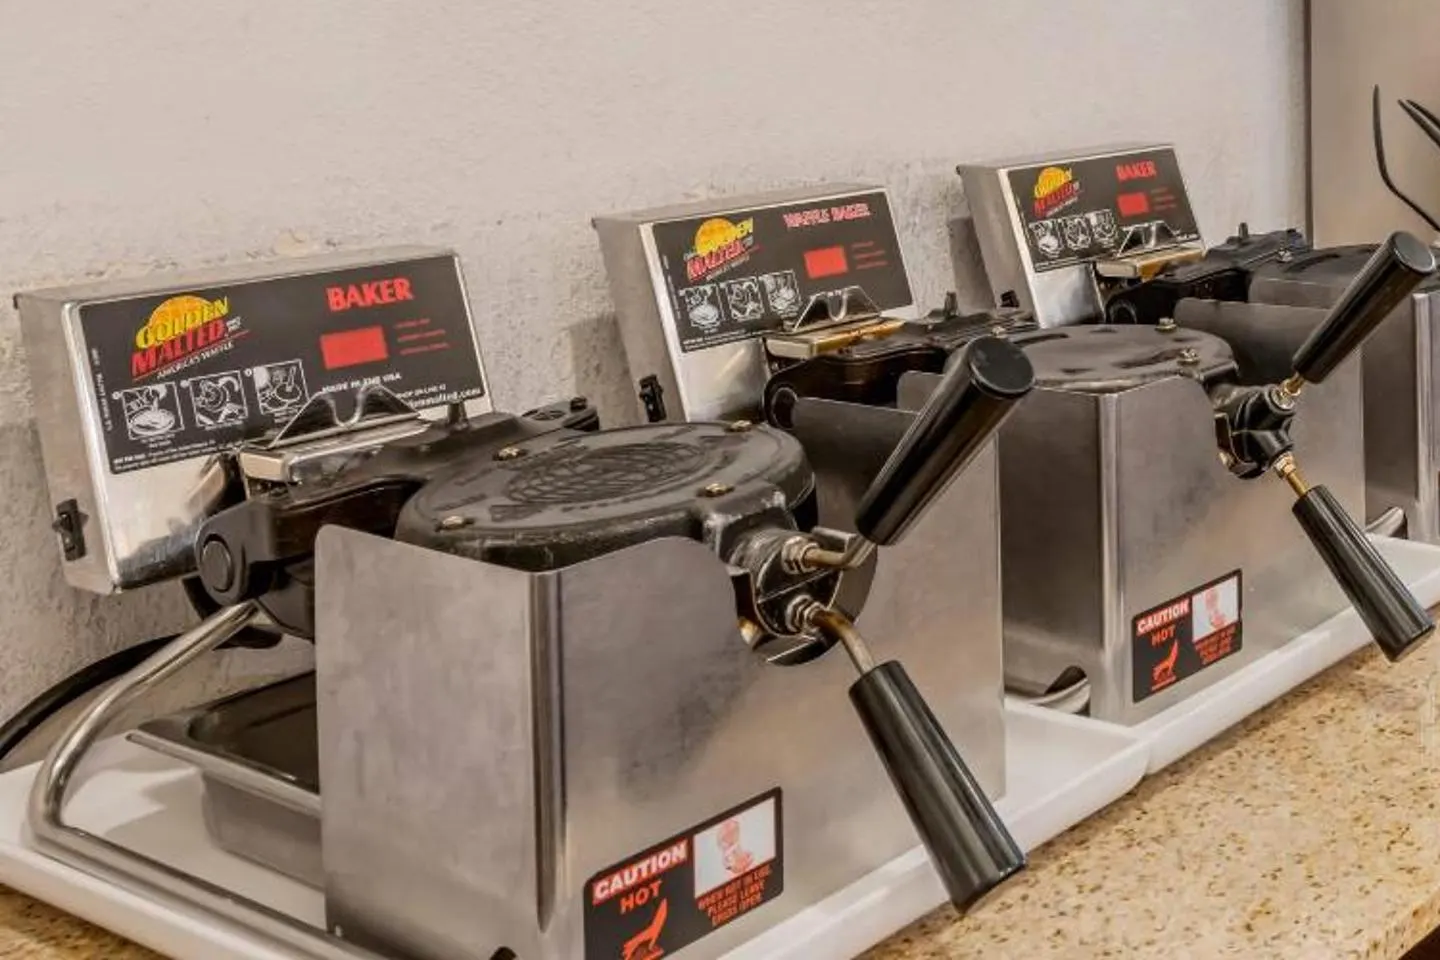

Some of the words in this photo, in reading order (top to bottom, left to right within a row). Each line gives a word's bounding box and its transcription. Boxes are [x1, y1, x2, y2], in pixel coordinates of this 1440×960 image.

[1116, 160, 1157, 181] BAKER
[326, 276, 416, 312] BAKER
[135, 295, 229, 349] GOLDEN
[131, 318, 226, 378] MALTED
[1137, 599, 1189, 635] CAUTION
[593, 839, 688, 902] CAUTION
[620, 879, 662, 915] HOT
